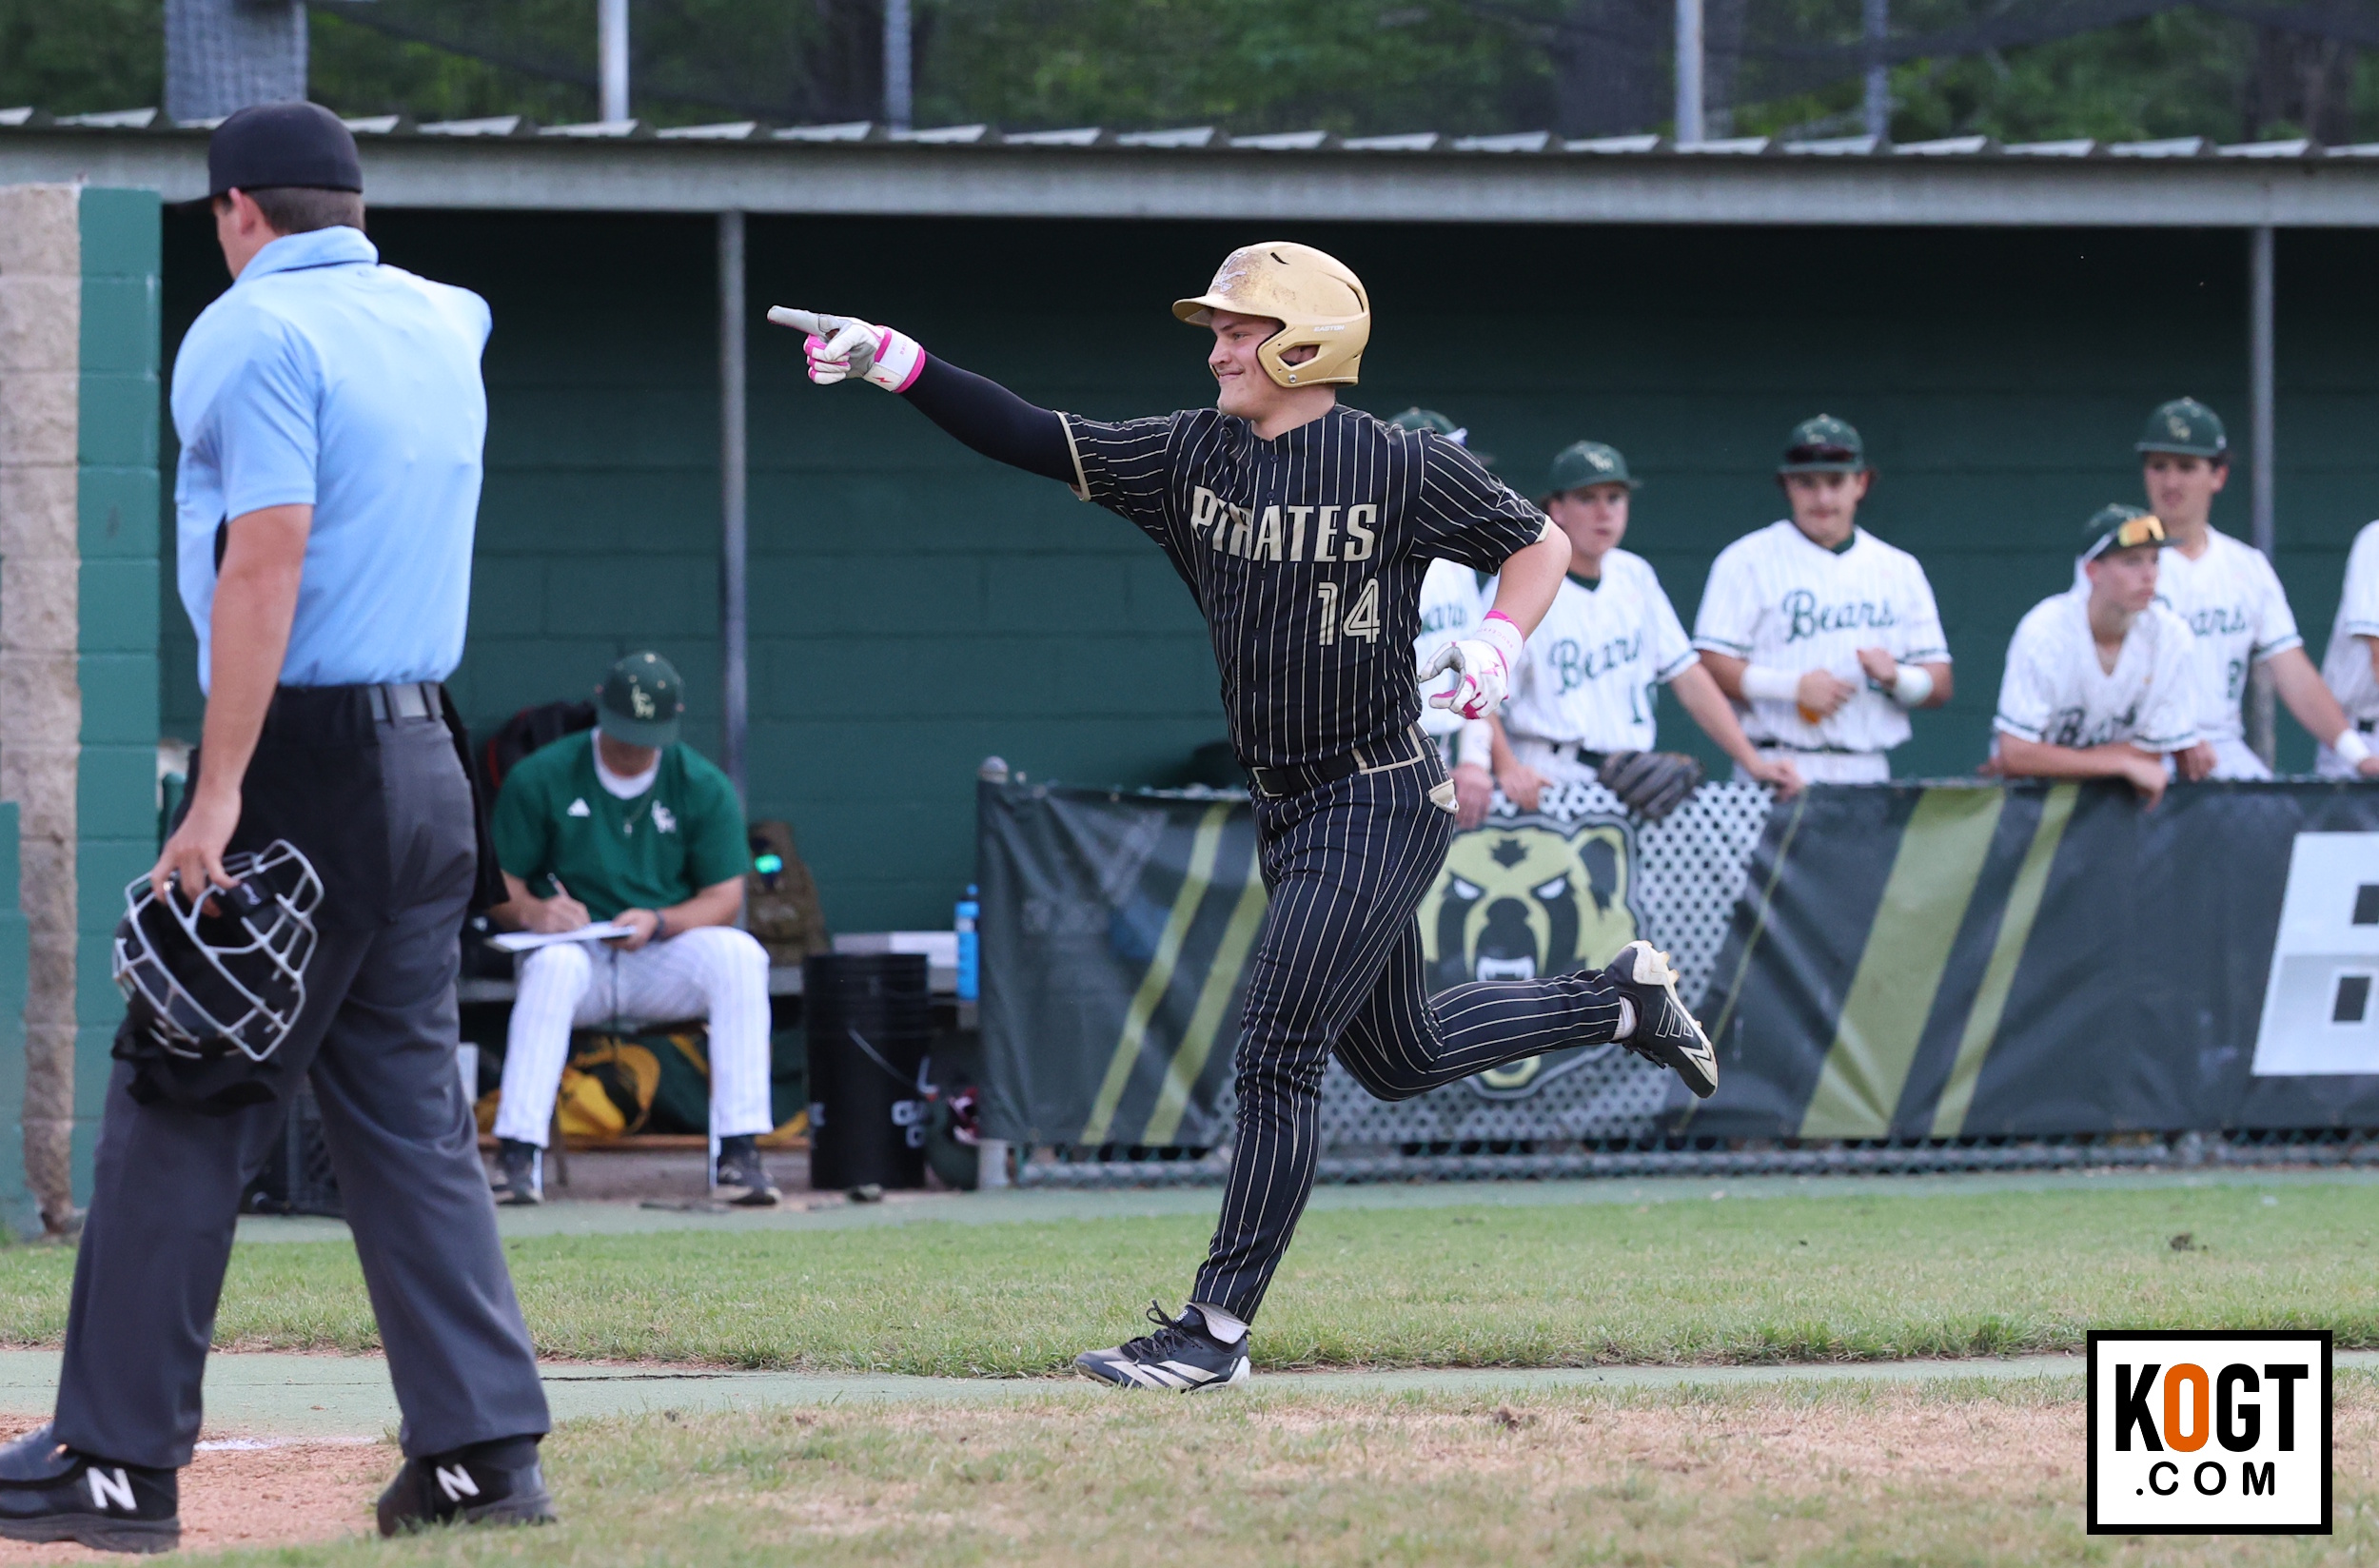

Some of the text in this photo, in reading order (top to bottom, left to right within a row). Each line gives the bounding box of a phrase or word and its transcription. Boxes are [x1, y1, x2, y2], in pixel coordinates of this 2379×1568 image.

[1190, 485, 1378, 562] PIRATES
[1318, 578, 1380, 646] 14
[1782, 590, 1896, 643] Bears
